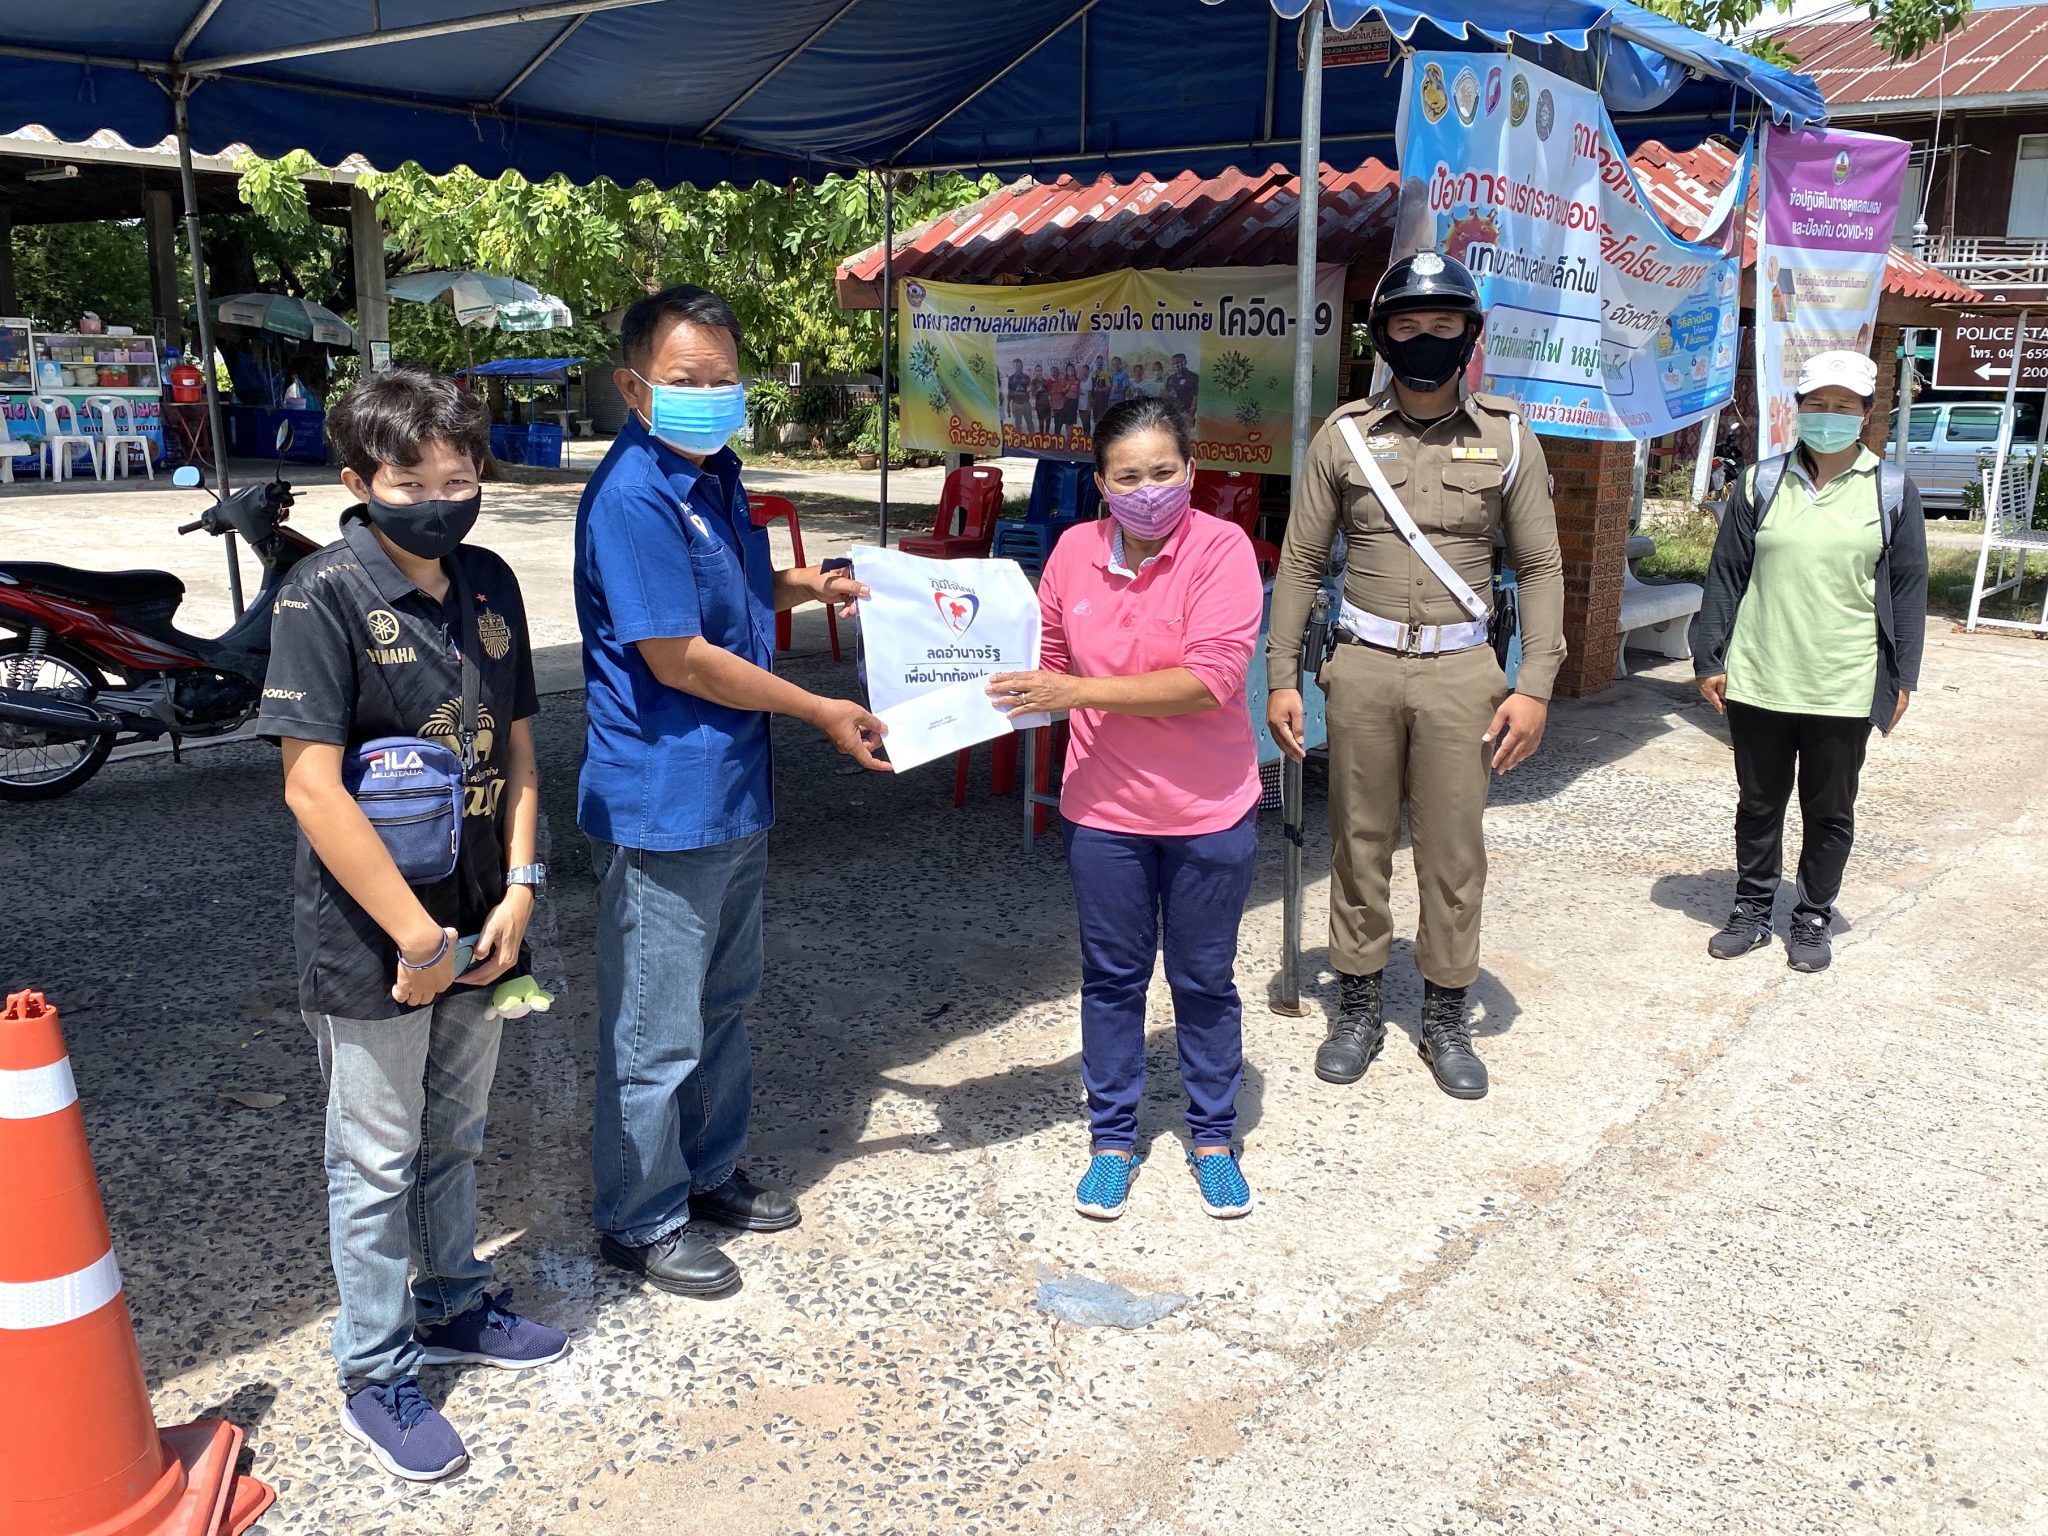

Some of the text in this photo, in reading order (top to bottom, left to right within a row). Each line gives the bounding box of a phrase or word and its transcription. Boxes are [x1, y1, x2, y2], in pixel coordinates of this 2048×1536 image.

[1835, 223, 1874, 240] COVID-19
[1090, 302, 1144, 331] ร่วมใจ
[1152, 301, 1213, 331] ต้านภัย
[1219, 296, 1333, 336] โควิด-9
[1956, 327, 2014, 341] POLICE
[1969, 345, 1994, 359] โทร.
[926, 643, 1001, 662] ลดอำนาจรัฐ
[367, 750, 424, 771] FILA
